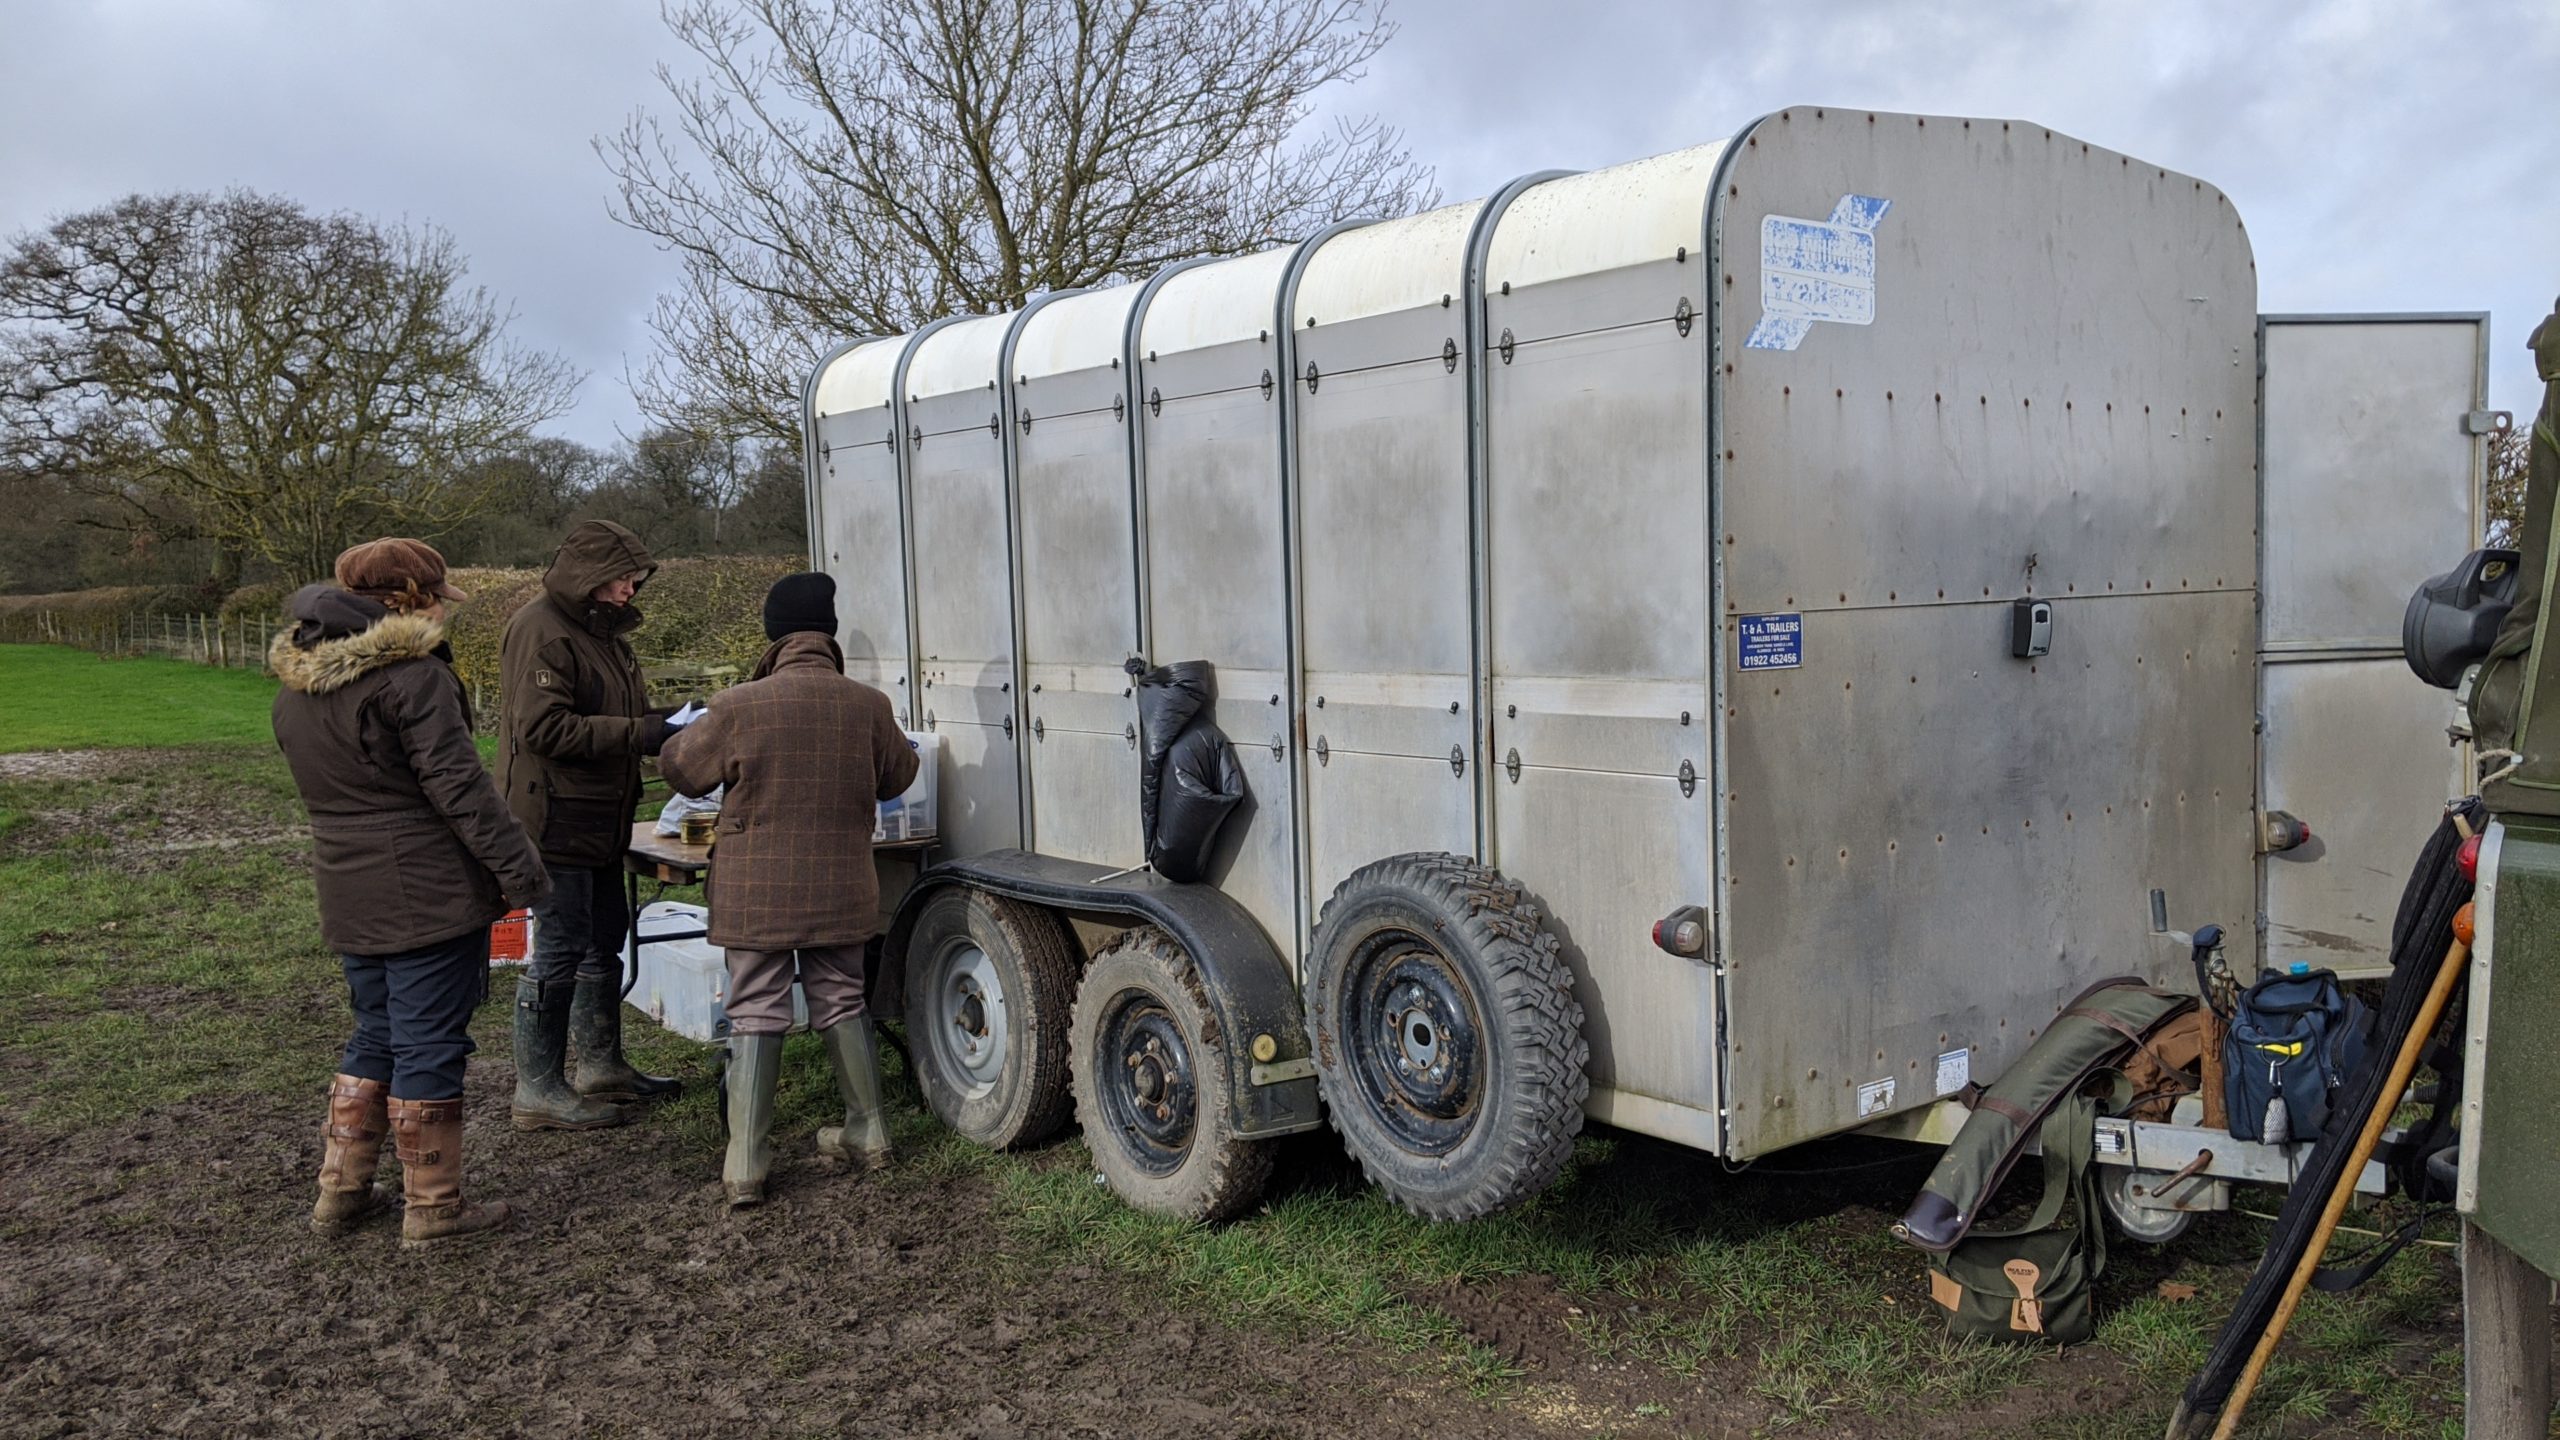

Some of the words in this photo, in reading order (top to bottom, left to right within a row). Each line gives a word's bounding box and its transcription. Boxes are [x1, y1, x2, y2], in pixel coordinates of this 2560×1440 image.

[1741, 624, 1748, 635] T.
[1750, 624, 1755, 634] &
[1756, 624, 1764, 634] A.
[1765, 622, 1799, 633] TRAILERS
[1744, 655, 1768, 666] 01922
[1769, 653, 1797, 664] 452456
